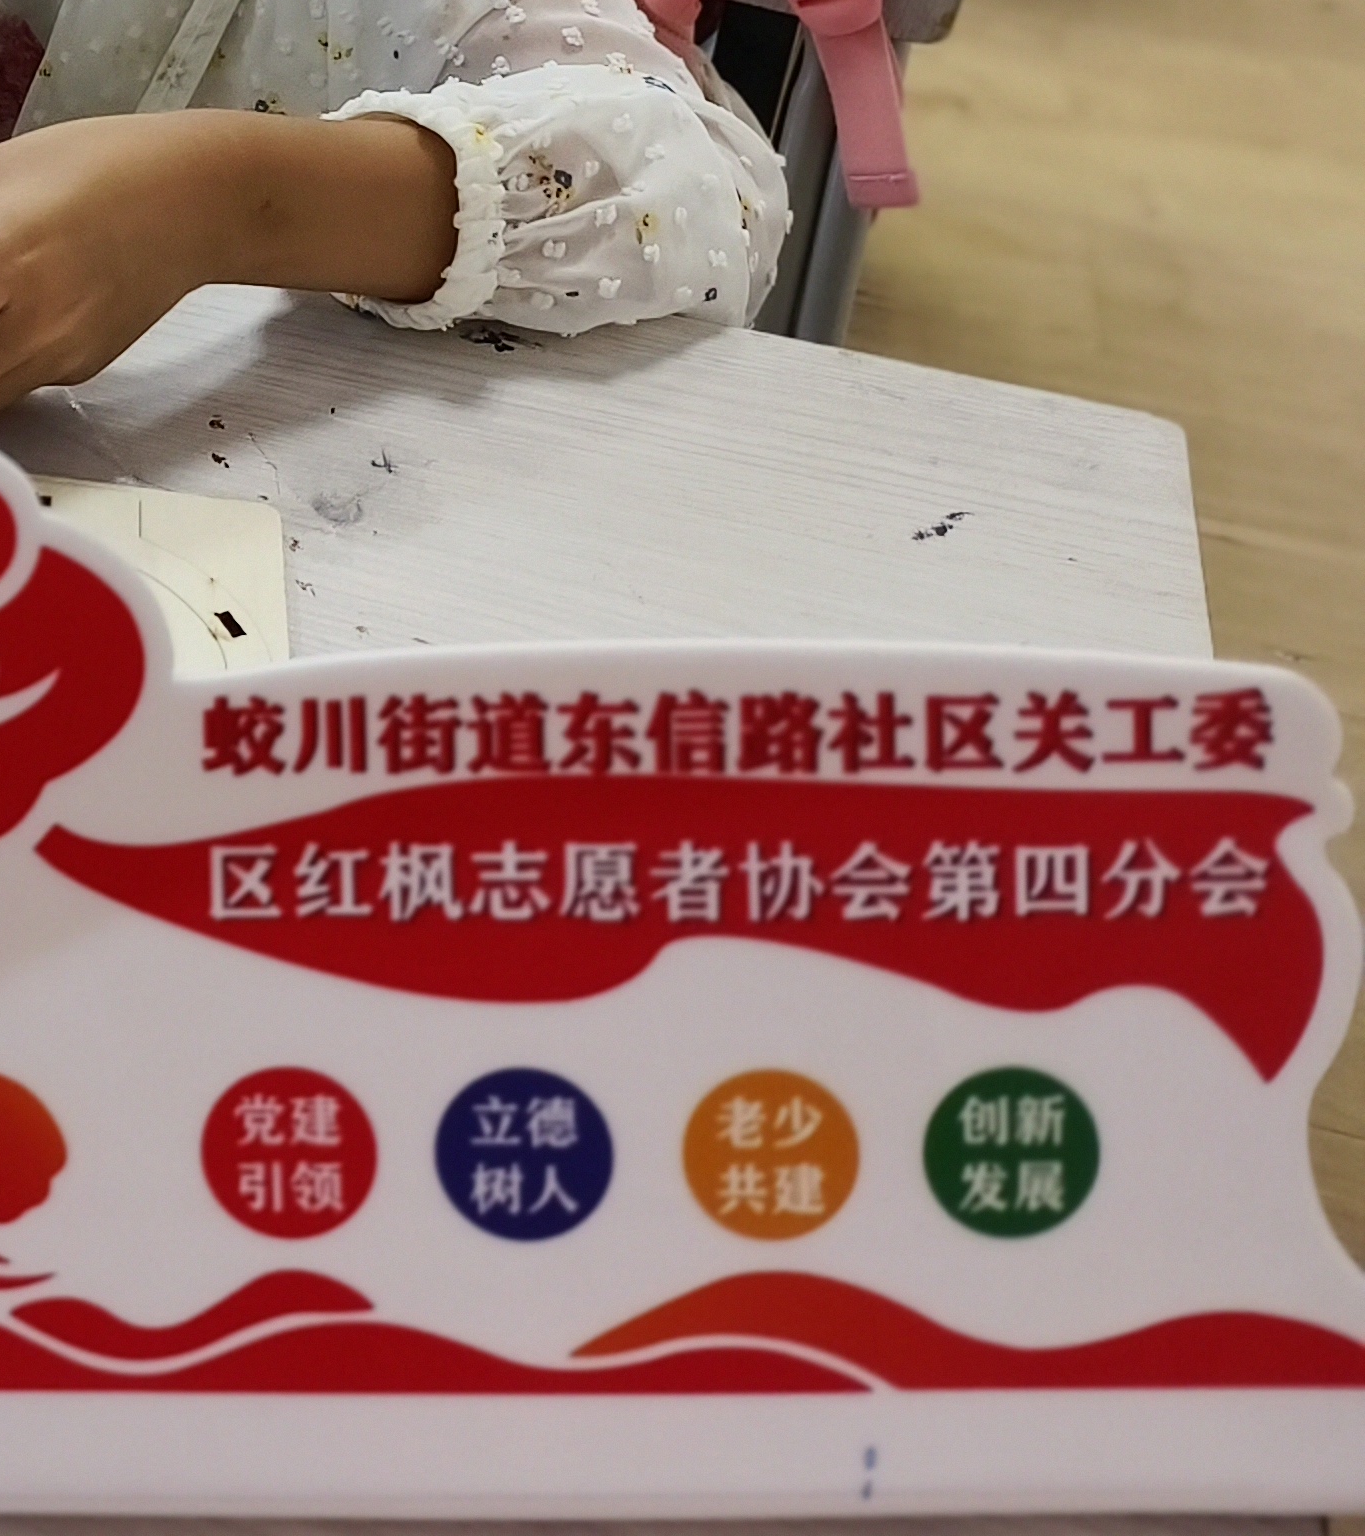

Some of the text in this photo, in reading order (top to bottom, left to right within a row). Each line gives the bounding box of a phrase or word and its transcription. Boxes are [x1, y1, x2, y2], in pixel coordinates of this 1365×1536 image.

[202, 690, 1274, 776] 蛟川街道东信路社区关工委
[208, 840, 1272, 925] 区红枫志愿者协会第四分会
[233, 1093, 344, 1148] 党建
[470, 1095, 580, 1150] 立德
[716, 1095, 825, 1151] 老少
[958, 1093, 1068, 1149] 创新
[236, 1160, 346, 1215] 引领
[470, 1162, 580, 1216] 树人
[717, 1161, 827, 1216] 共建
[958, 1160, 1068, 1215] 发展
